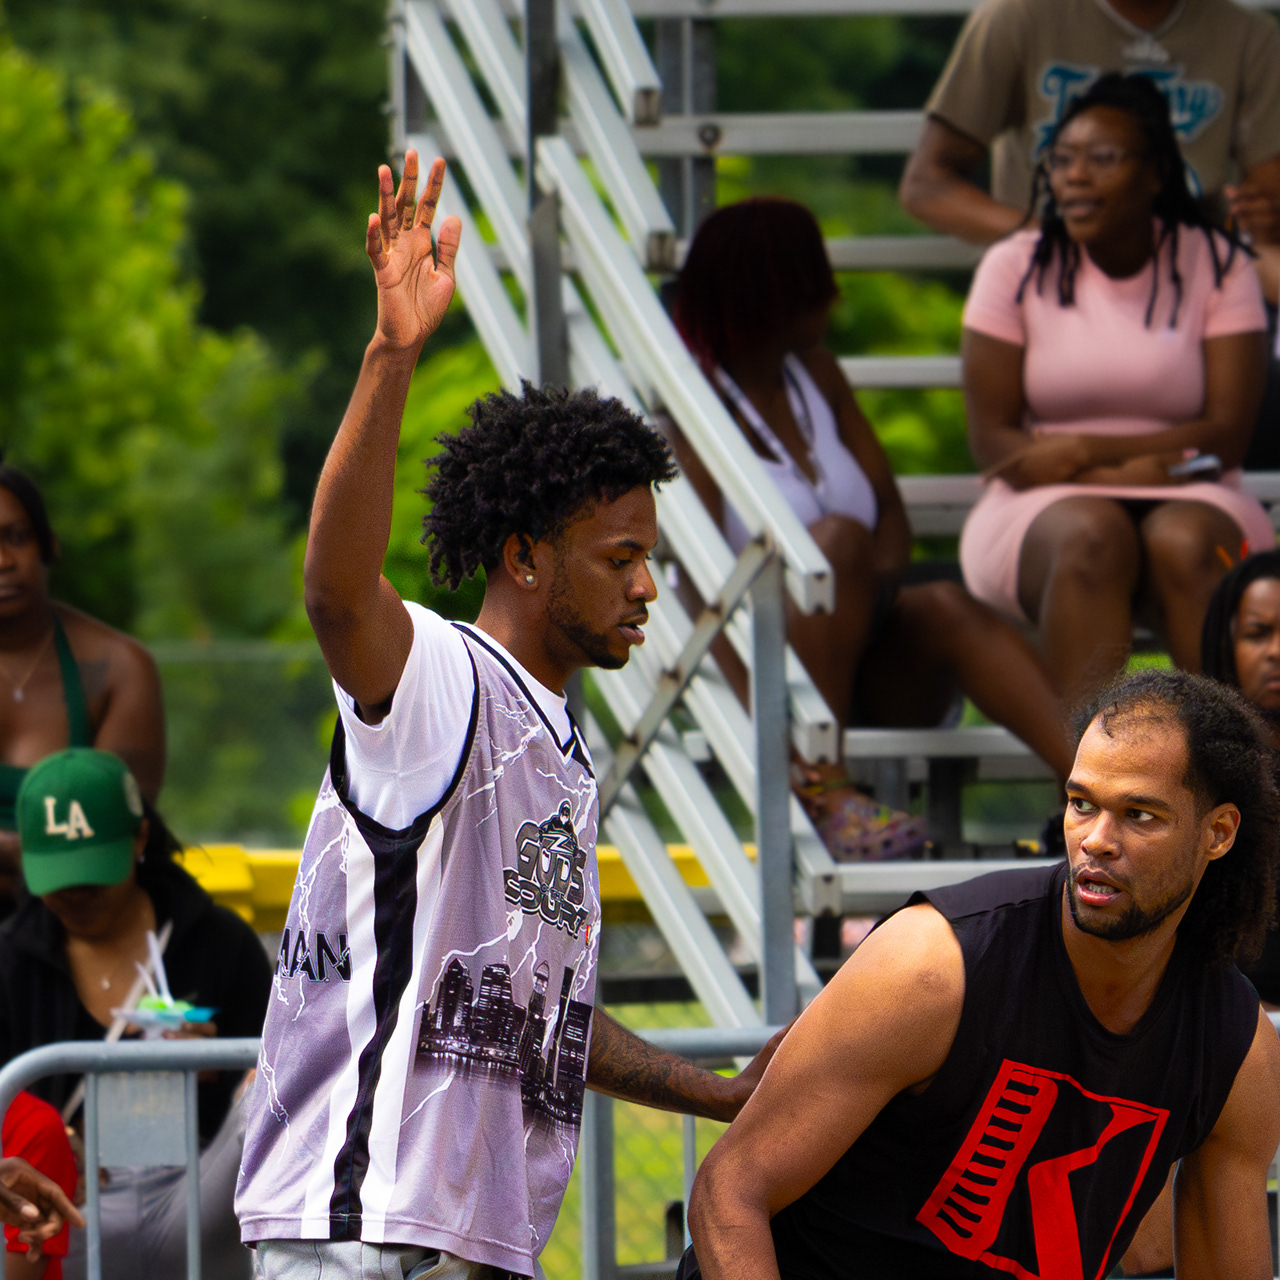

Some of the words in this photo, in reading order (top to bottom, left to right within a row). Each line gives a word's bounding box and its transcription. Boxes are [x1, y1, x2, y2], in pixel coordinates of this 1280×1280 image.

[44, 796, 95, 839] LA
[515, 820, 588, 906] GODS
[503, 867, 590, 941] COURT
